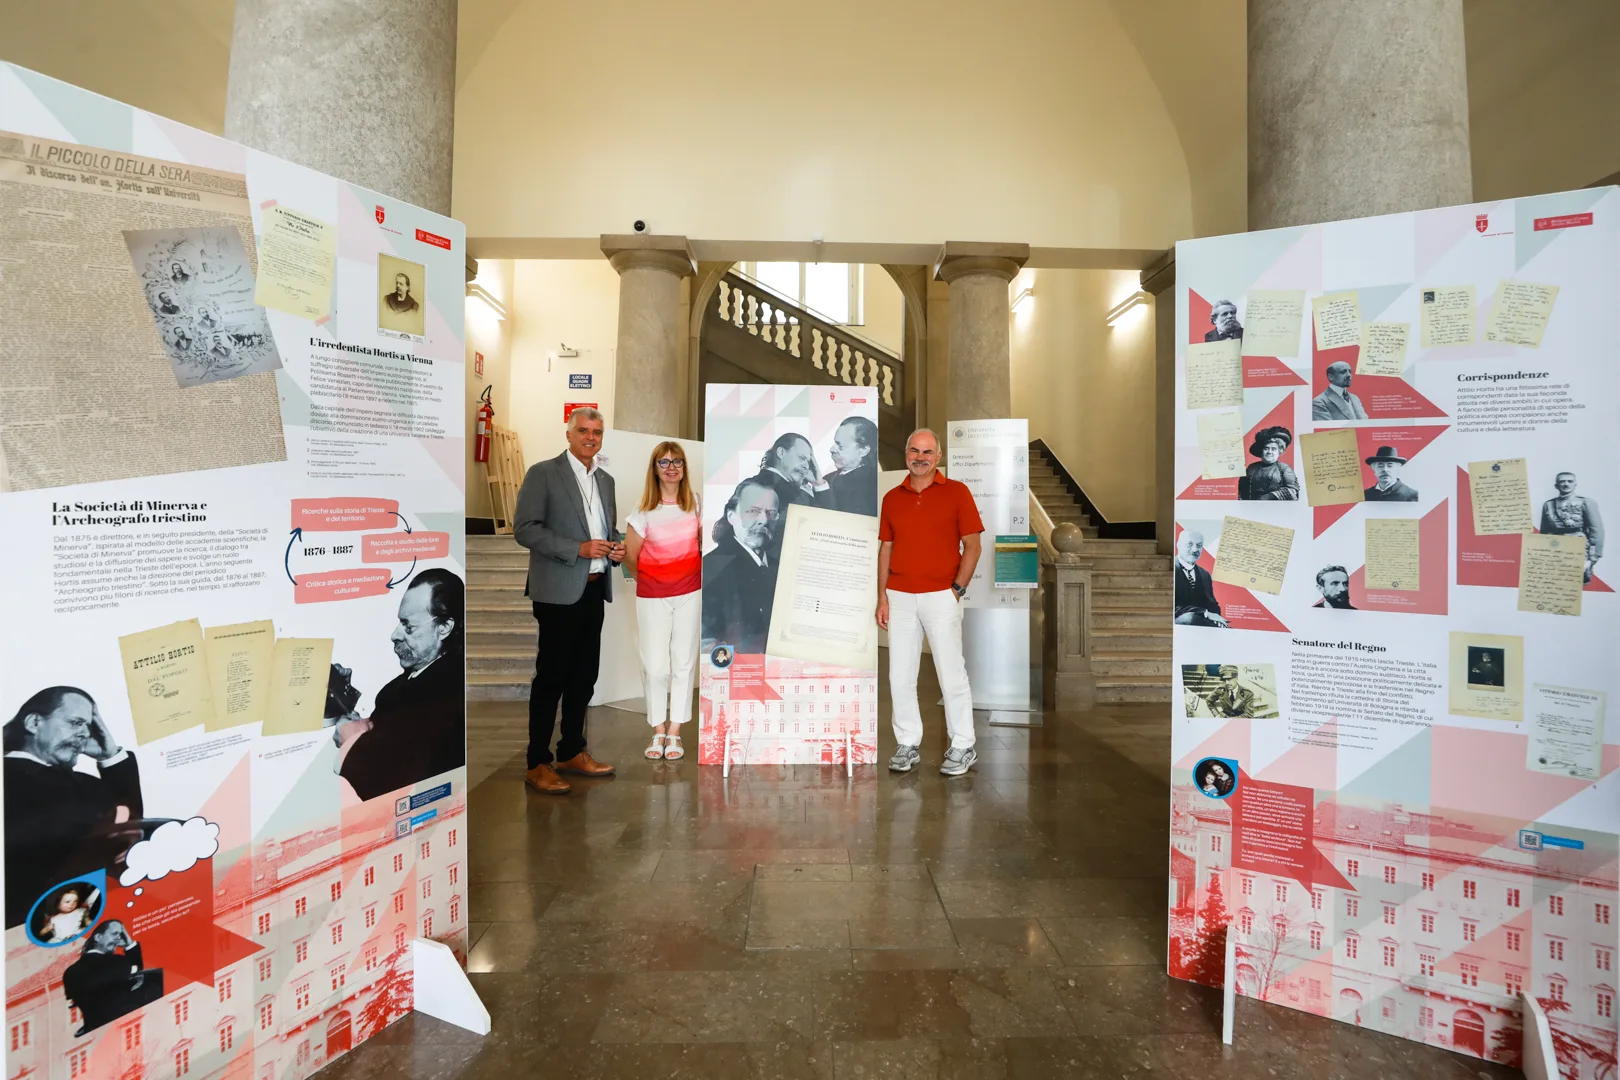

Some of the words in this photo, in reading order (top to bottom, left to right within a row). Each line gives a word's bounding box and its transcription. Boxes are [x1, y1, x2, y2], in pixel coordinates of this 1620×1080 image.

[30, 144, 42, 160] IL
[46, 147, 110, 170] PICCOLO
[114, 158, 154, 177] DELLA
[159, 166, 190, 182] SERA
[310, 337, 371, 356] L'irredentista
[373, 348, 398, 360] Hortis
[406, 354, 433, 366] Vienna
[1457, 371, 1549, 382] Corrispondenze
[52, 501, 69, 512] La
[74, 501, 126, 512] Società
[130, 501, 142, 511] di
[146, 501, 197, 511] Minerva
[52, 513, 149, 527] l'Archeografo
[152, 513, 206, 523] triestino
[1013, 516, 1024, 524] P.2
[151, 531, 178, 540] seguito
[179, 530, 216, 539] presidente,
[54, 551, 88, 560] "Società
[100, 549, 135, 557] Minerva"
[137, 548, 174, 557] promuove
[304, 547, 325, 556] 1876
[333, 546, 353, 555] 1887
[334, 586, 359, 595] culturale
[54, 602, 120, 614] reciprocamente.
[1292, 638, 1335, 649] Senatore
[1337, 641, 1352, 650] del
[1354, 643, 1386, 654] Regno
[133, 653, 166, 670] ATTILIO
[168, 645, 195, 660] HORTIS
